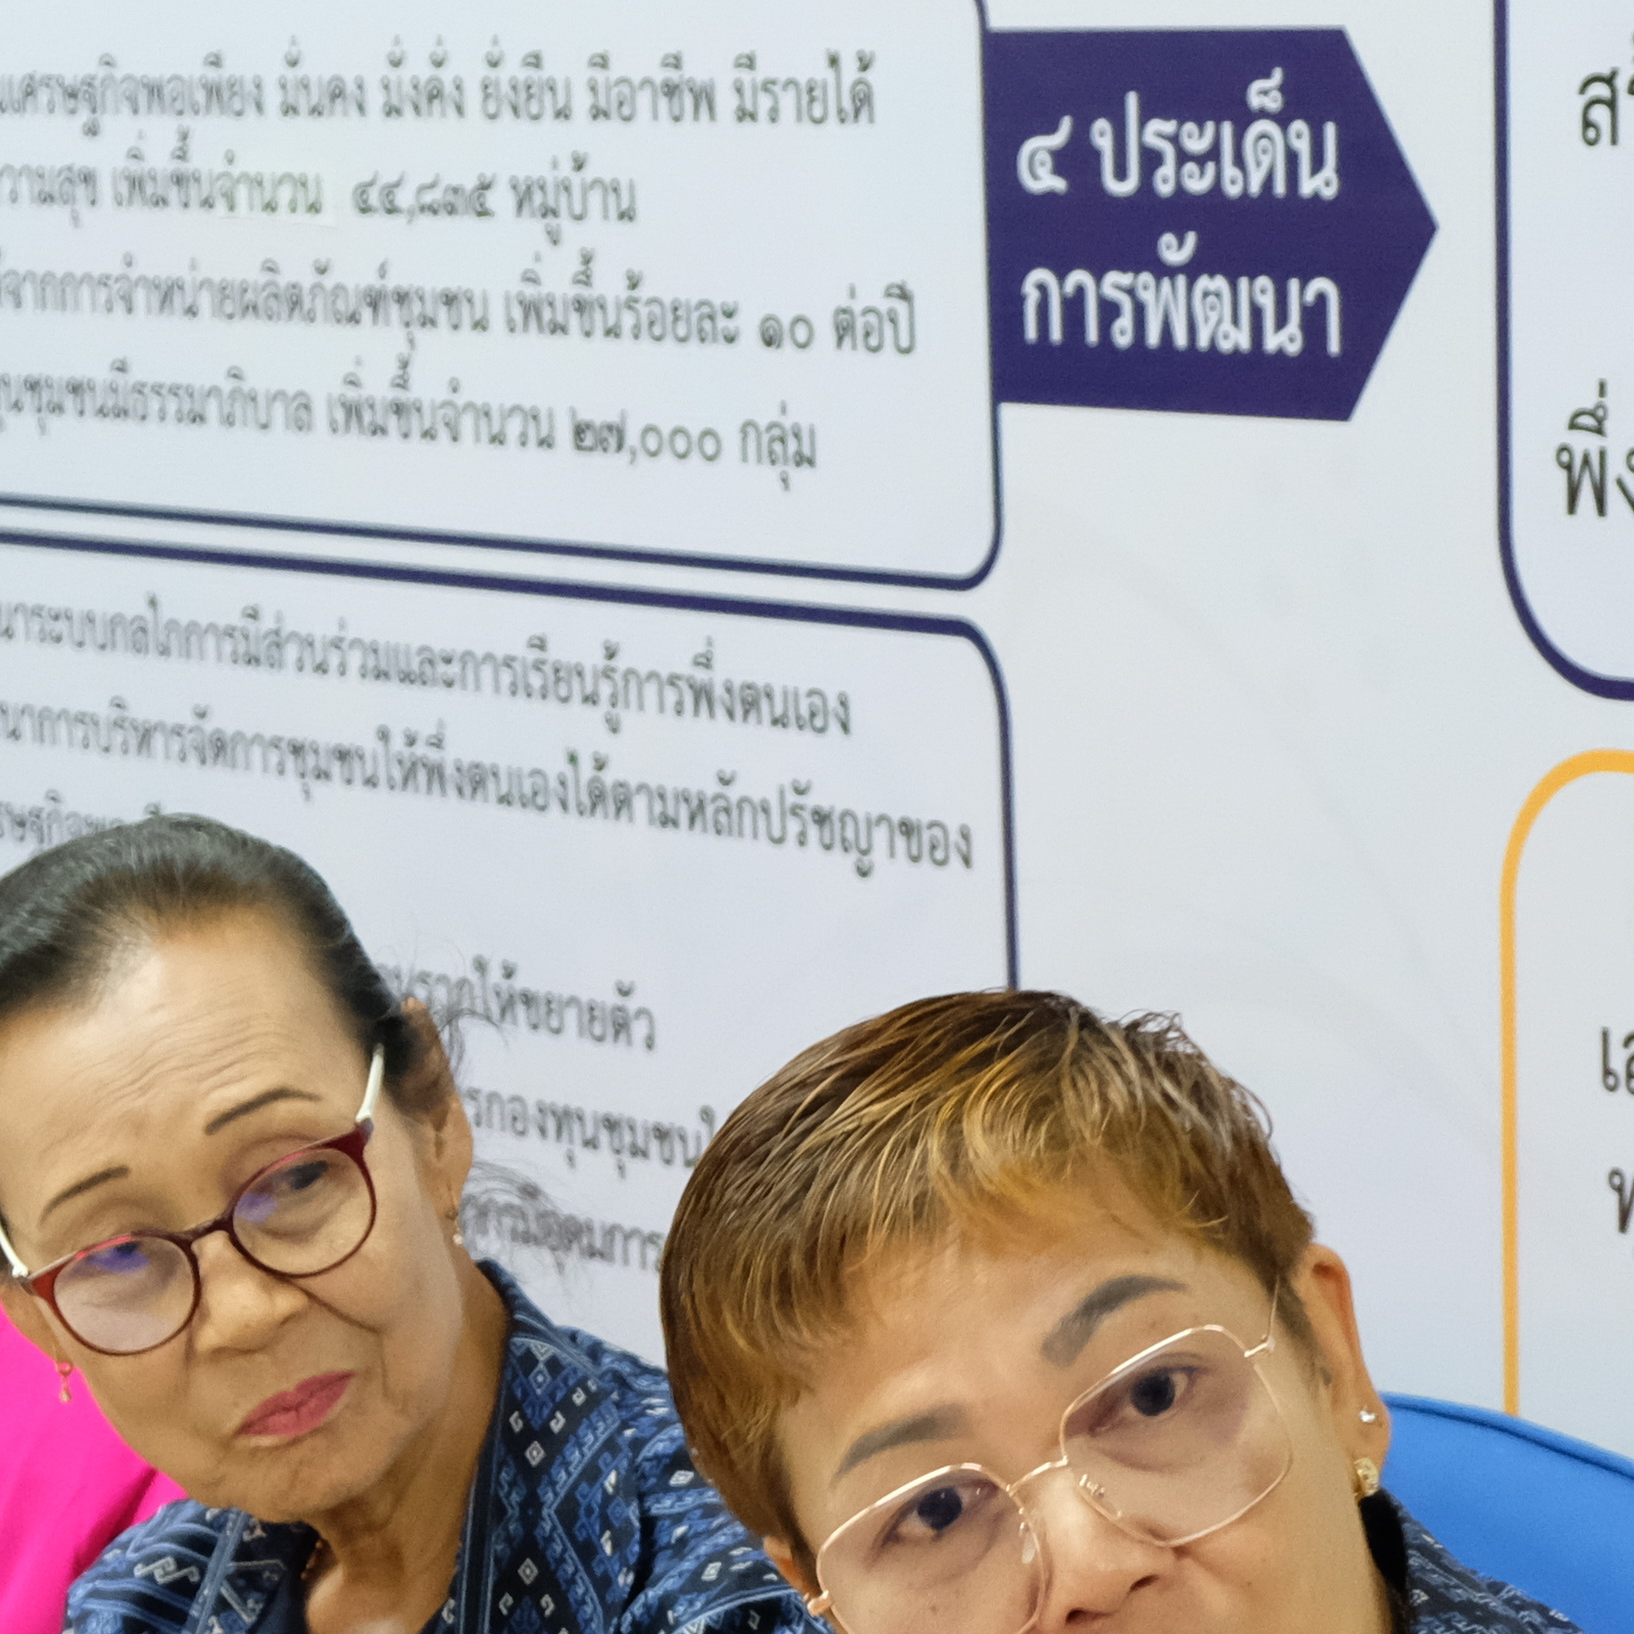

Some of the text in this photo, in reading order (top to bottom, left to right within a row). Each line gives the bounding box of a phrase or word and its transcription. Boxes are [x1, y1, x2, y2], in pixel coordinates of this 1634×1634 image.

[279, 36, 366, 120] มั่นคง
[381, 36, 466, 122] มั่งคั่ง
[479, 36, 572, 122] ยั่งยืน
[588, 50, 717, 124] มีอาชีพ
[733, 47, 875, 126] มีรายได้
[1017, 66, 1338, 200] ๔ ประเด็น
[112, 123, 324, 214] เพิ่มขึ้นจำนวน
[510, 151, 637, 247] หมู่บ้าน
[505, 248, 739, 343] เพิ่มขึ้นร้อยละ
[758, 313, 815, 350] ๑๐
[833, 280, 917, 354] ต่อปี
[1021, 230, 1342, 358] การพัฒนา
[327, 352, 555, 450] เพิ่มขึ้นจำนวน
[740, 400, 816, 492] กลุ่ม
